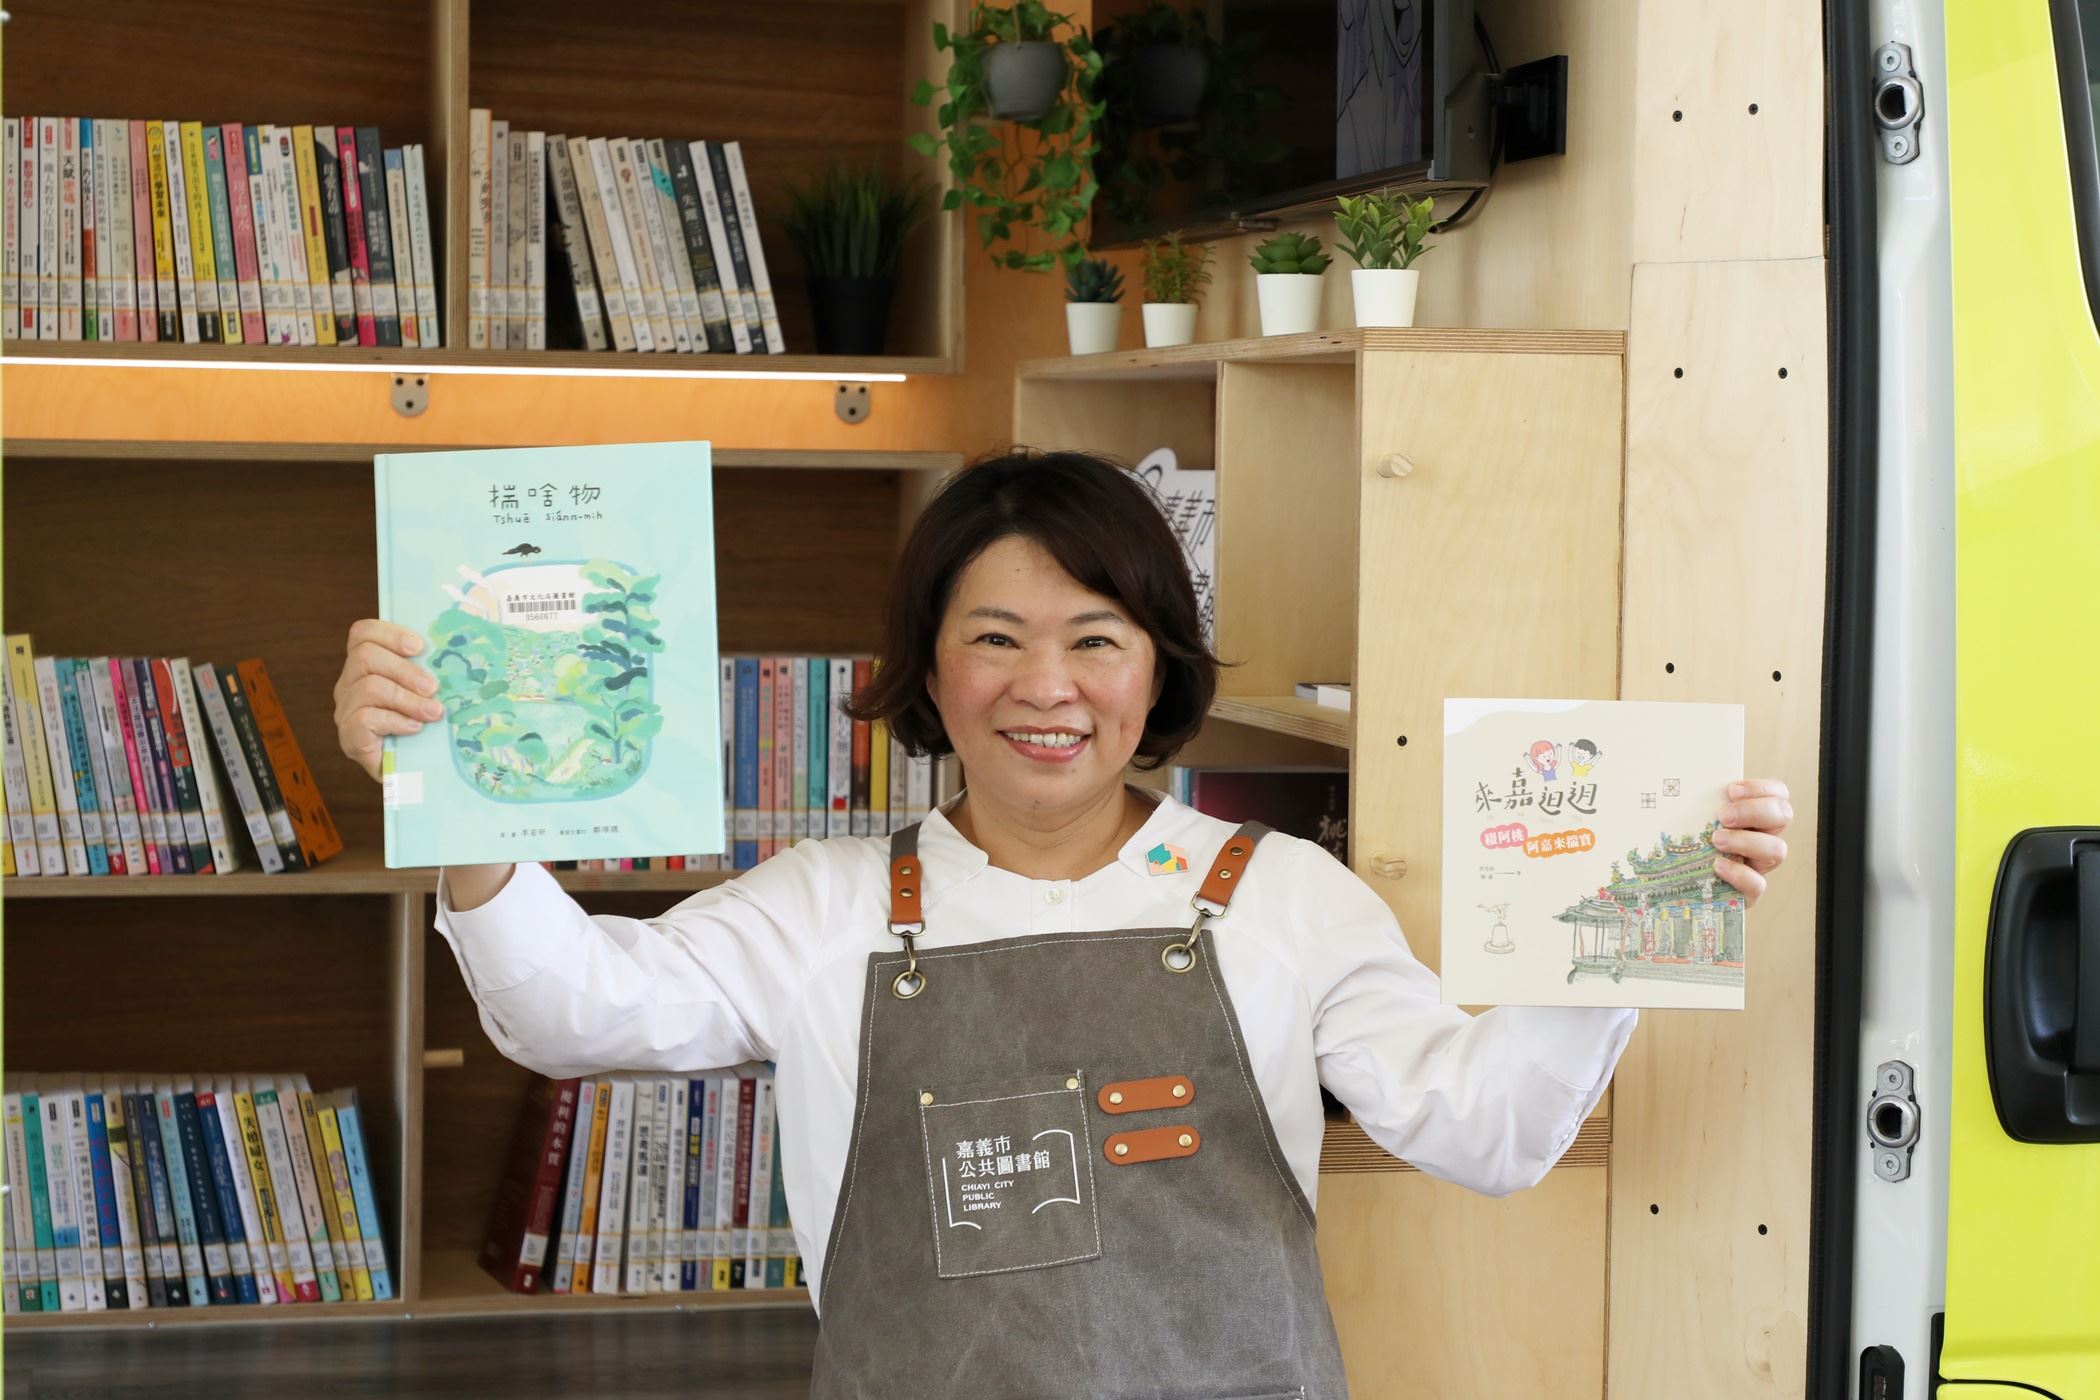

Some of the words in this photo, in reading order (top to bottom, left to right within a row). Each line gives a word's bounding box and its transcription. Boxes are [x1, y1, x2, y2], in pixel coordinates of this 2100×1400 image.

[487, 482, 602, 511] 揣啥物
[956, 1135, 1011, 1160] 嘉義市
[958, 1149, 1051, 1178] 公共圖書館
[961, 1183, 990, 1192] CHIAYI
[994, 1180, 1015, 1189] CITY
[962, 1192, 995, 1202] PUBLIC
[963, 1201, 1002, 1212] LIBRARY
